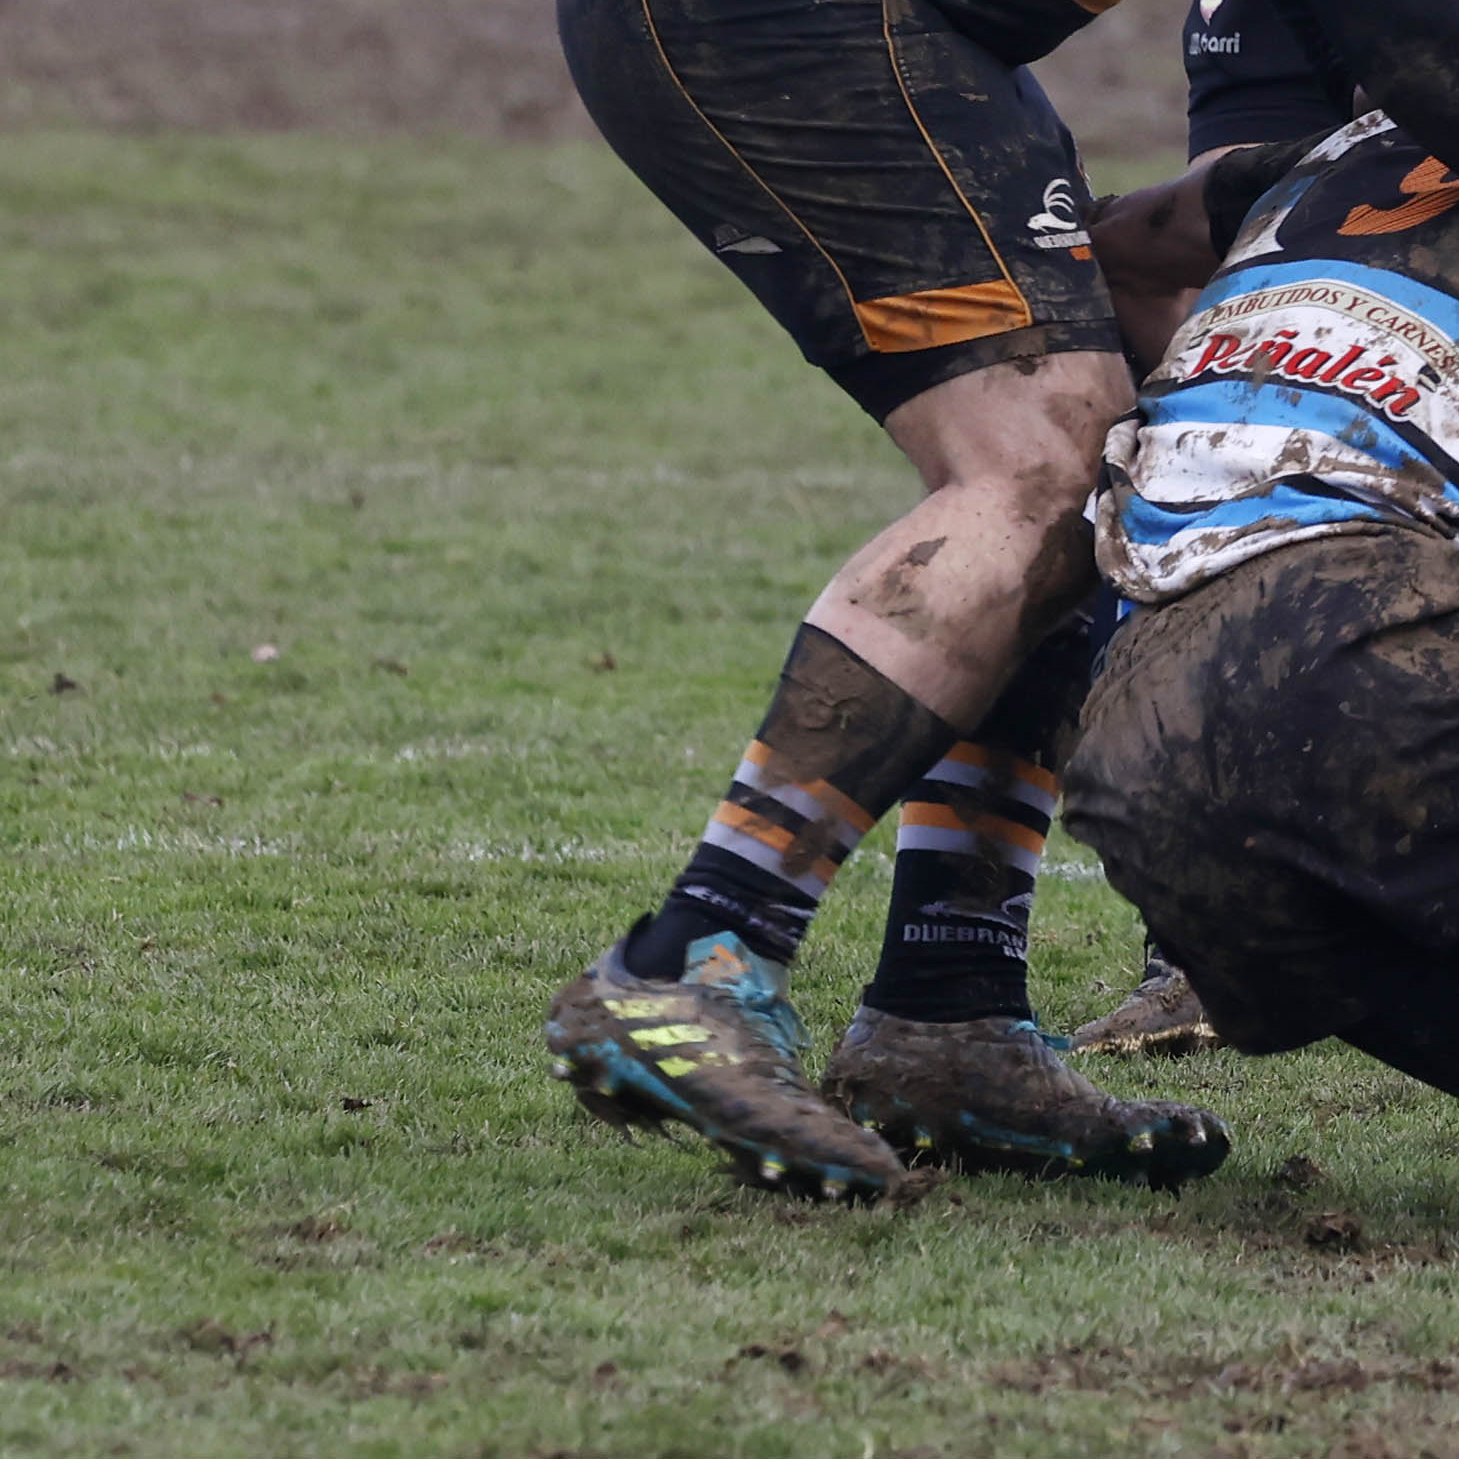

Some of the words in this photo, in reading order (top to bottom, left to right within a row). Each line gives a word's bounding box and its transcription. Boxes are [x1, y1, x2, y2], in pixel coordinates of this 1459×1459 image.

[1208, 287, 1346, 326] EMBUTIDOS
[1344, 296, 1368, 311] Y
[1366, 307, 1456, 369] CARNES
[1183, 329, 1421, 416] Peñalén
